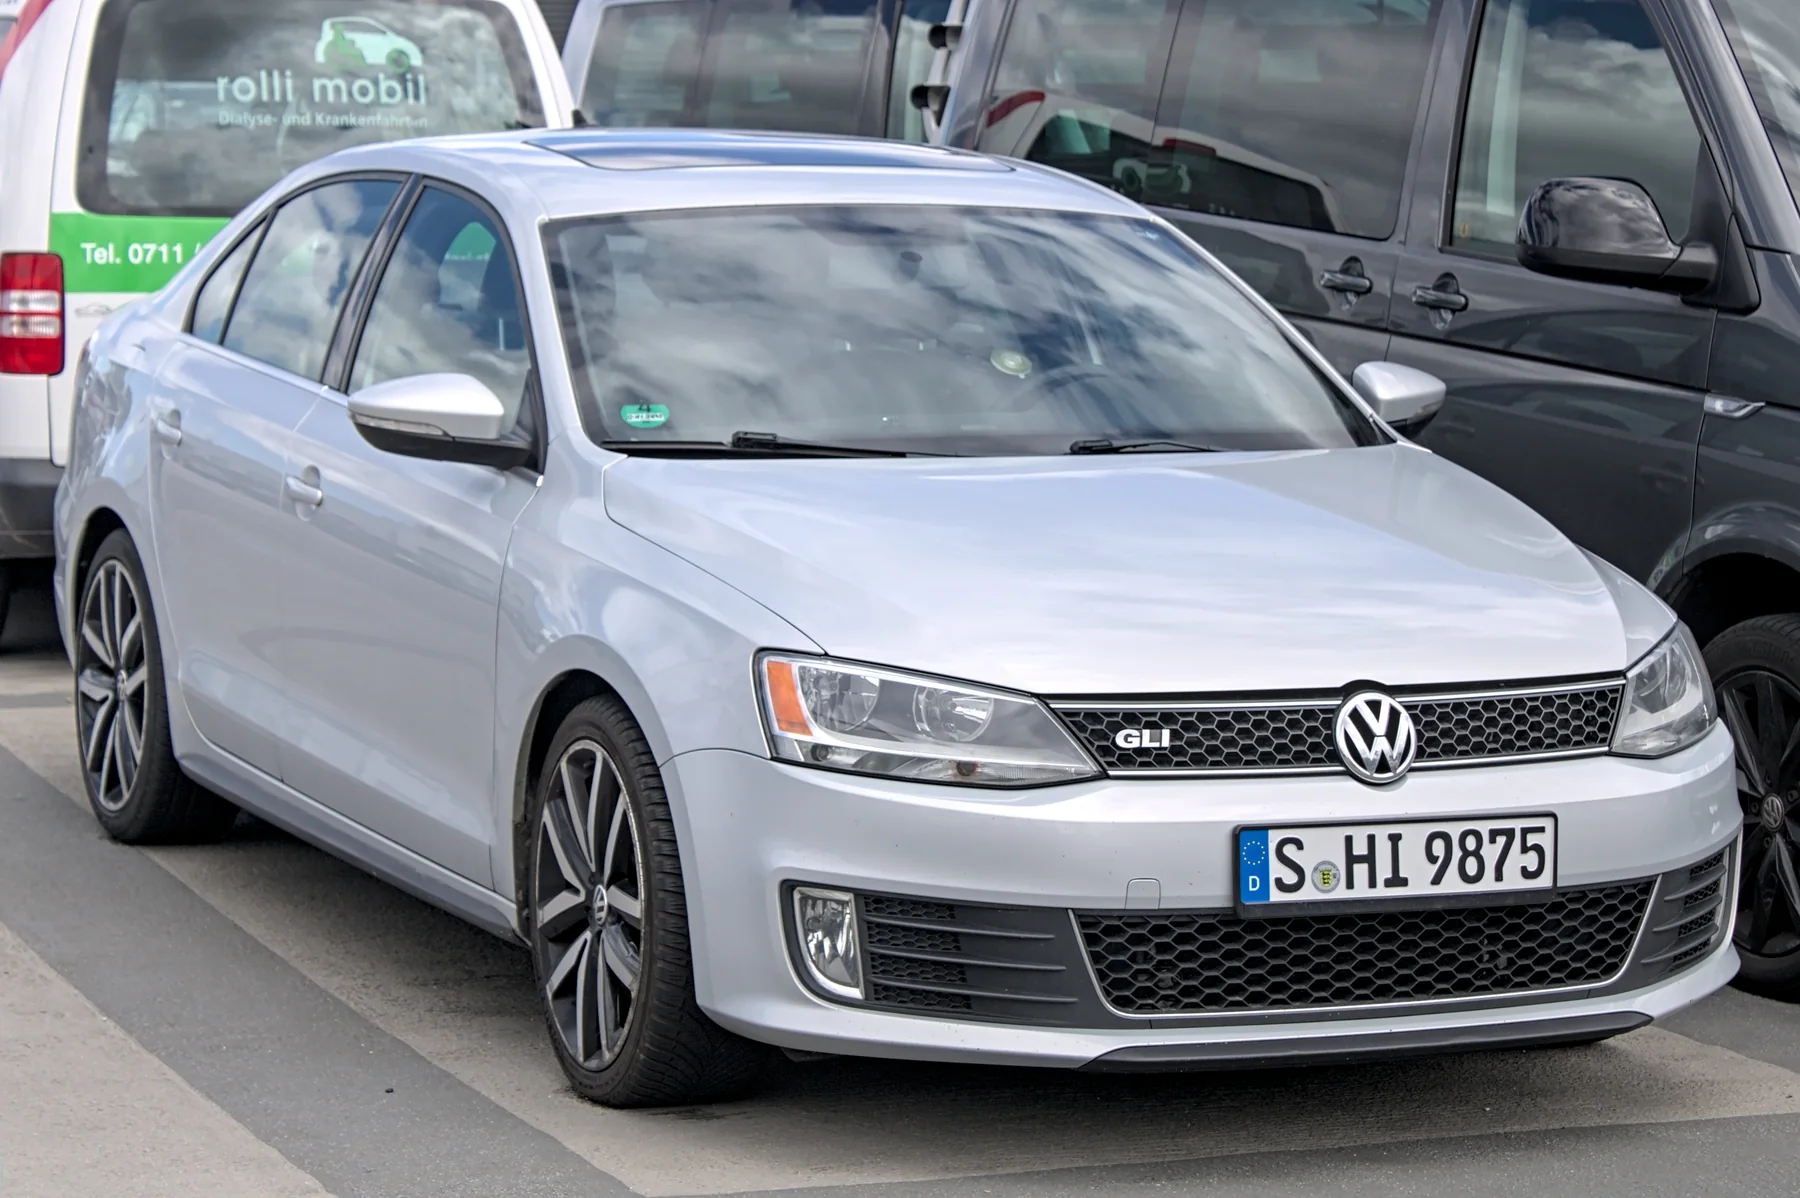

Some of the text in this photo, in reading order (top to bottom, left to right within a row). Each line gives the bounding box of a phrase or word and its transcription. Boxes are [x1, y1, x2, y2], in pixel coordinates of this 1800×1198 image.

[216, 69, 426, 105] rolli mobil
[281, 111, 311, 126] und
[80, 242, 122, 264] Tel.
[127, 242, 183, 264] 0711
[1115, 728, 1171, 749] GLI
[1274, 825, 1546, 893] S HI 9875
[1248, 875, 1261, 892] D
